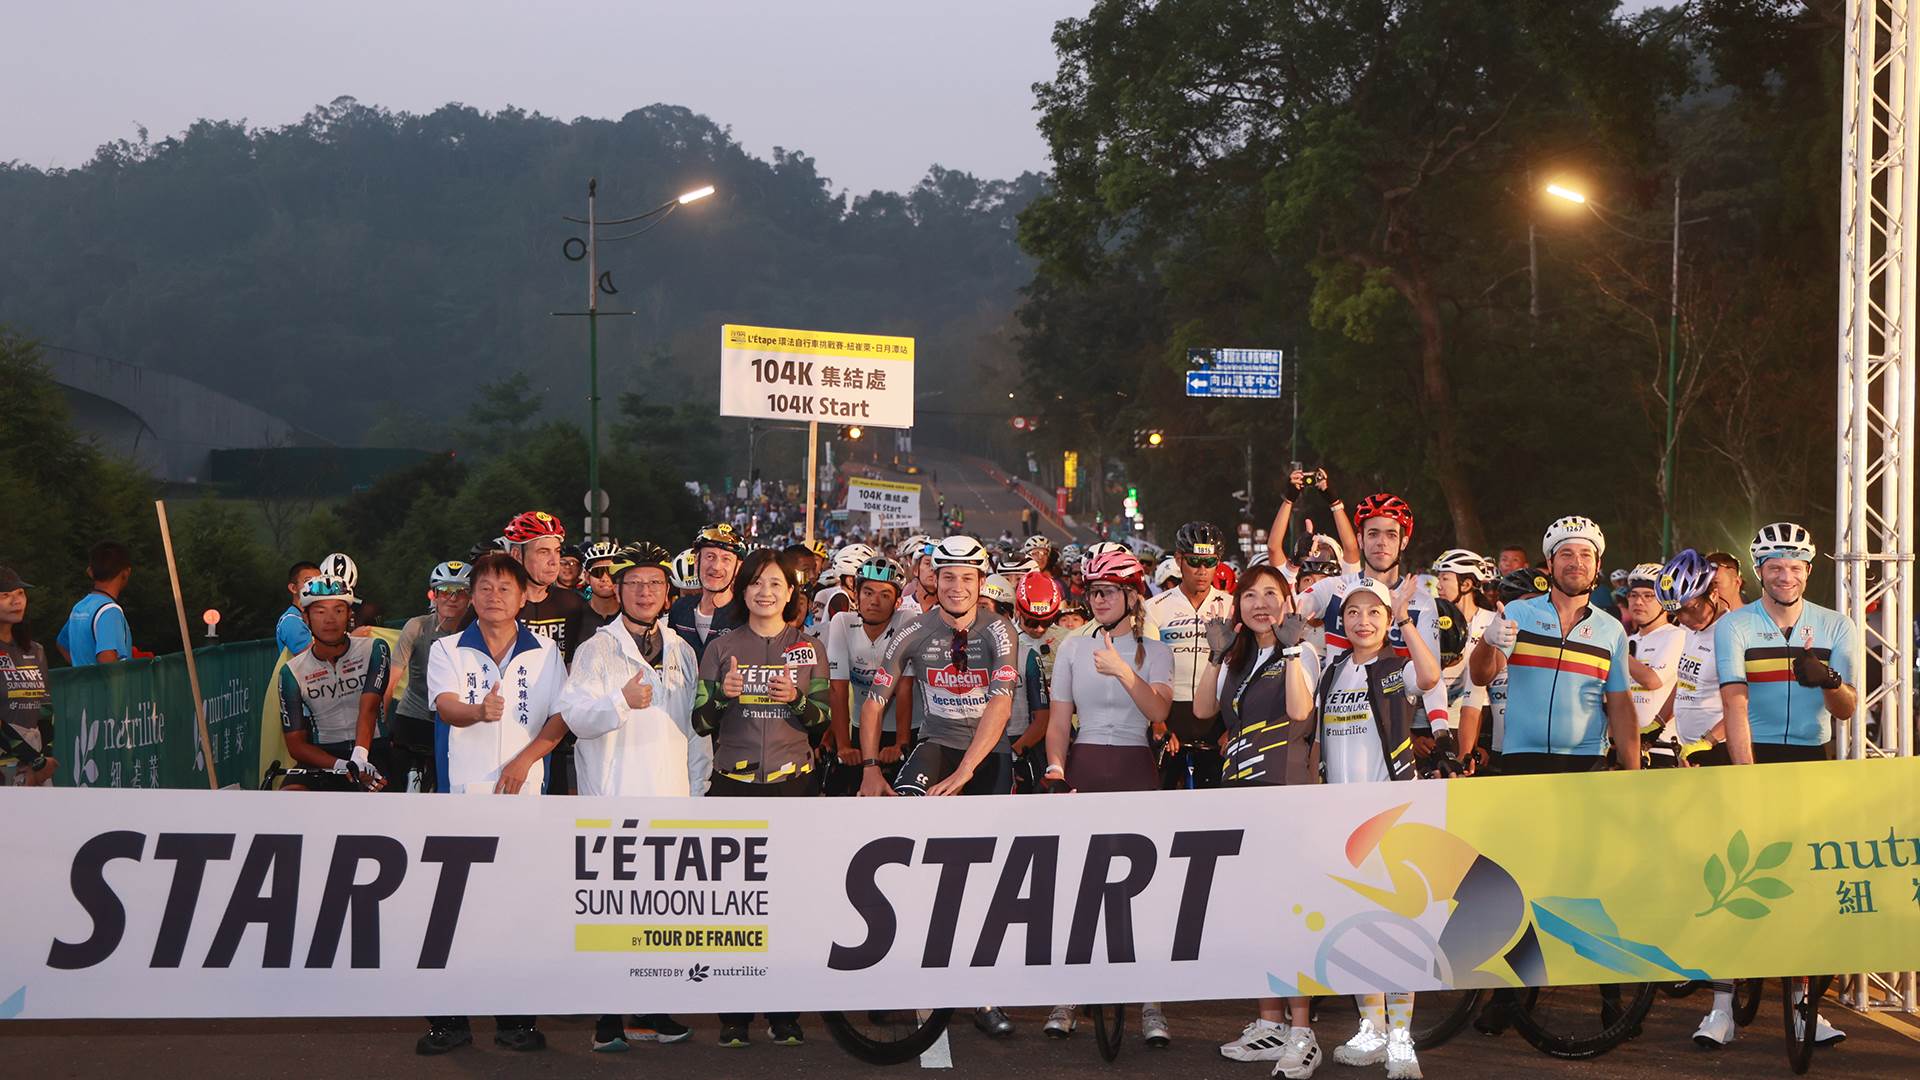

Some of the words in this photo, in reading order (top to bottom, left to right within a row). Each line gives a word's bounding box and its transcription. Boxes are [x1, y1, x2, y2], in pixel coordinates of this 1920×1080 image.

[748, 334, 777, 346] L'Étape
[751, 359, 814, 386] 104K
[821, 366, 887, 390] 集結處
[767, 394, 814, 414] 104K
[819, 397, 870, 418] Start
[859, 489, 882, 500] 104K
[864, 502, 881, 511] 104K
[883, 503, 902, 513] Start
[527, 623, 566, 639] TAPE
[992, 619, 1013, 656] Alpecin
[789, 649, 814, 661] 2580
[307, 674, 367, 699] bryton
[934, 671, 982, 687] Alpecin
[517, 665, 529, 725] 南投縣政府
[932, 693, 991, 706] deceuninck
[750, 708, 791, 719] nutrilite
[1353, 703, 1370, 712] LAKE
[1332, 725, 1368, 736] nutrilite
[575, 819, 768, 881] L'ÉTAPE
[46, 830, 499, 970] START
[575, 889, 623, 915] SUN
[630, 889, 704, 915] MOON
[712, 890, 769, 915] LAKE
[827, 829, 1245, 971] START
[632, 936, 642, 946] BY
[644, 930, 682, 946] TOUR
[685, 930, 703, 946] DE
[706, 930, 763, 946] FRANCE
[630, 968, 672, 977] PRESENTED
[674, 968, 684, 977] BY
[713, 964, 767, 977] nutrilite
